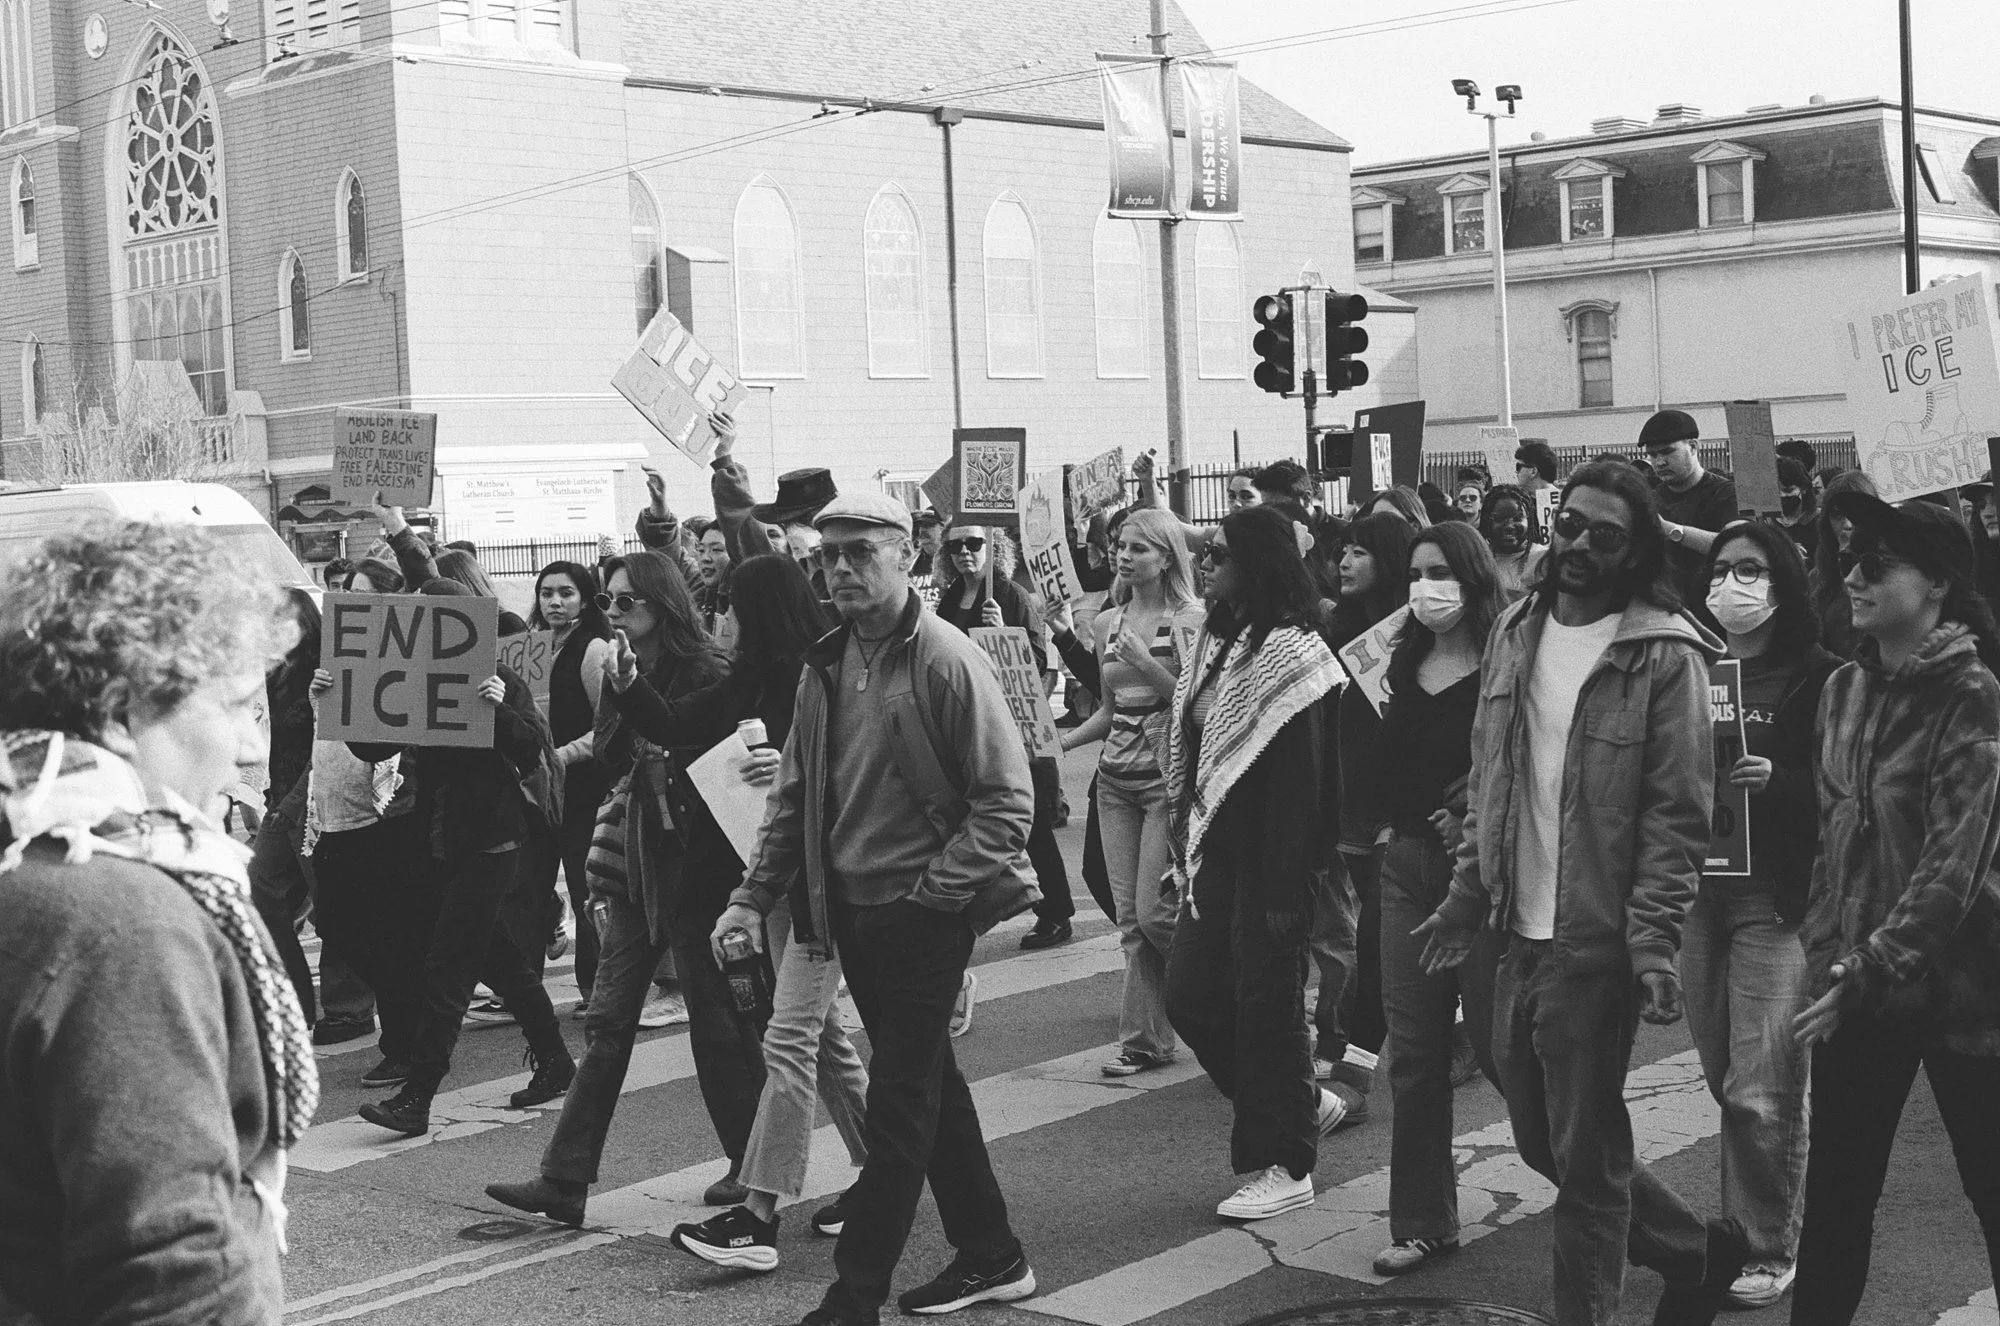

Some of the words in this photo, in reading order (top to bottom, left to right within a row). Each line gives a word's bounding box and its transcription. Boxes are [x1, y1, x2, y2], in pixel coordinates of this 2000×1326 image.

[1219, 135, 1229, 155] We
[1219, 157, 1229, 202] Pursue
[1847, 322, 1861, 360] I
[1871, 297, 1954, 354] PREFER
[1954, 287, 1979, 330] MY
[657, 324, 737, 413] ICE
[1881, 335, 1962, 394] ICE
[346, 412, 394, 428] ABOLISH
[400, 412, 420, 430] ICE
[348, 429, 376, 446] LAND
[381, 429, 414, 446] BACK
[335, 445, 375, 460] PROTECT
[377, 448, 404, 460] TRANS
[405, 449, 430, 464] LIVES
[339, 460, 362, 475] FREE
[365, 459, 424, 478] PALESTINE
[1865, 430, 1999, 497] CRUSHE
[342, 475, 363, 488] END
[365, 474, 416, 490] FASCISM
[462, 490, 492, 498] Lutheran
[492, 489, 515, 498] Church
[965, 501, 993, 509] FLOWERS
[995, 501, 1014, 509] GROW
[1029, 542, 1063, 582] MELT
[1040, 571, 1071, 601] ICE
[333, 603, 478, 660] END
[983, 634, 1023, 669] HOT
[991, 668, 1039, 698] OPLE
[341, 669, 469, 731] ICE
[1015, 721, 1042, 751] CE
[728, 1234, 754, 1248] HOKA
